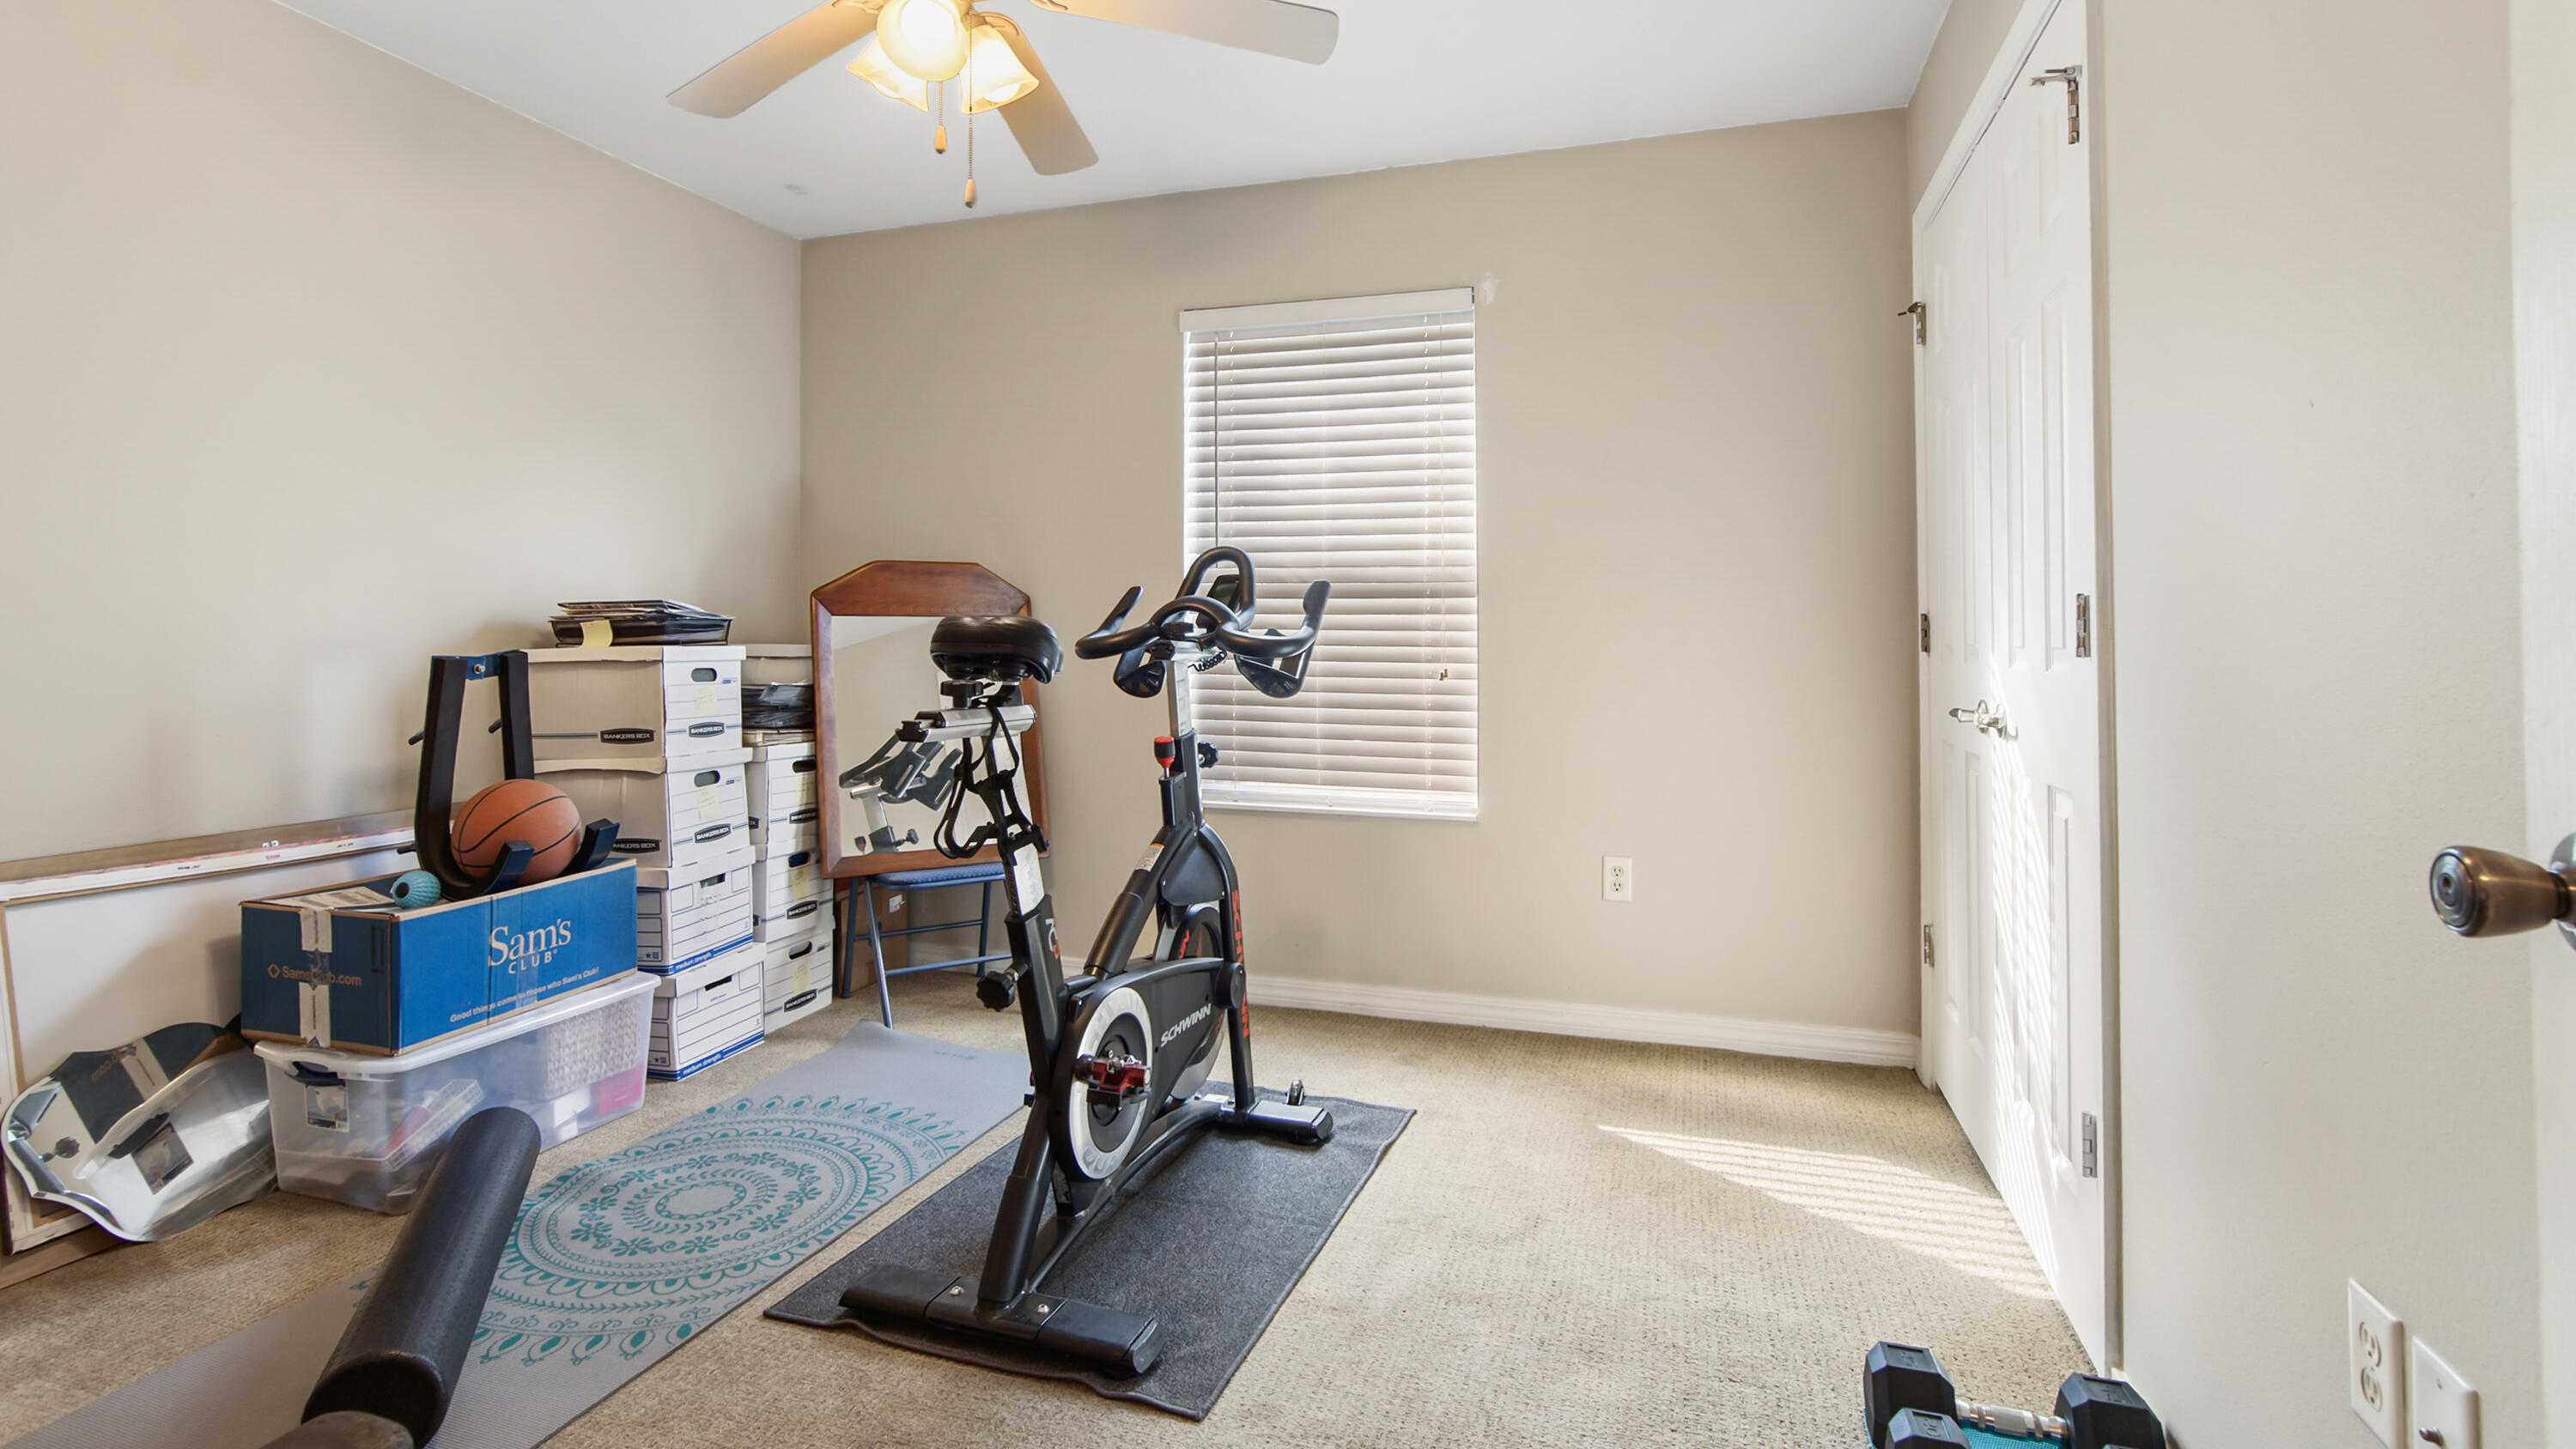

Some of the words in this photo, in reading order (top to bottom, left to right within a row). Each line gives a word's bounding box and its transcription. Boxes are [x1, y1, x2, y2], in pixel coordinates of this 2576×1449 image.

[487, 918, 572, 967] Sam's
[282, 965, 362, 986] SamsClub.com
[507, 950, 553, 974] CLUB
[449, 1009, 472, 1022] Good
[472, 1002, 495, 1016] things
[496, 996, 517, 1007] come
[517, 991, 526, 999] to
[526, 985, 546, 996] those
[547, 979, 562, 990] who
[562, 973, 582, 985] Sam's
[582, 966, 599, 979] Club!
[1160, 1002, 1212, 1048] SCHWINN
[683, 1062, 702, 1076] medium
